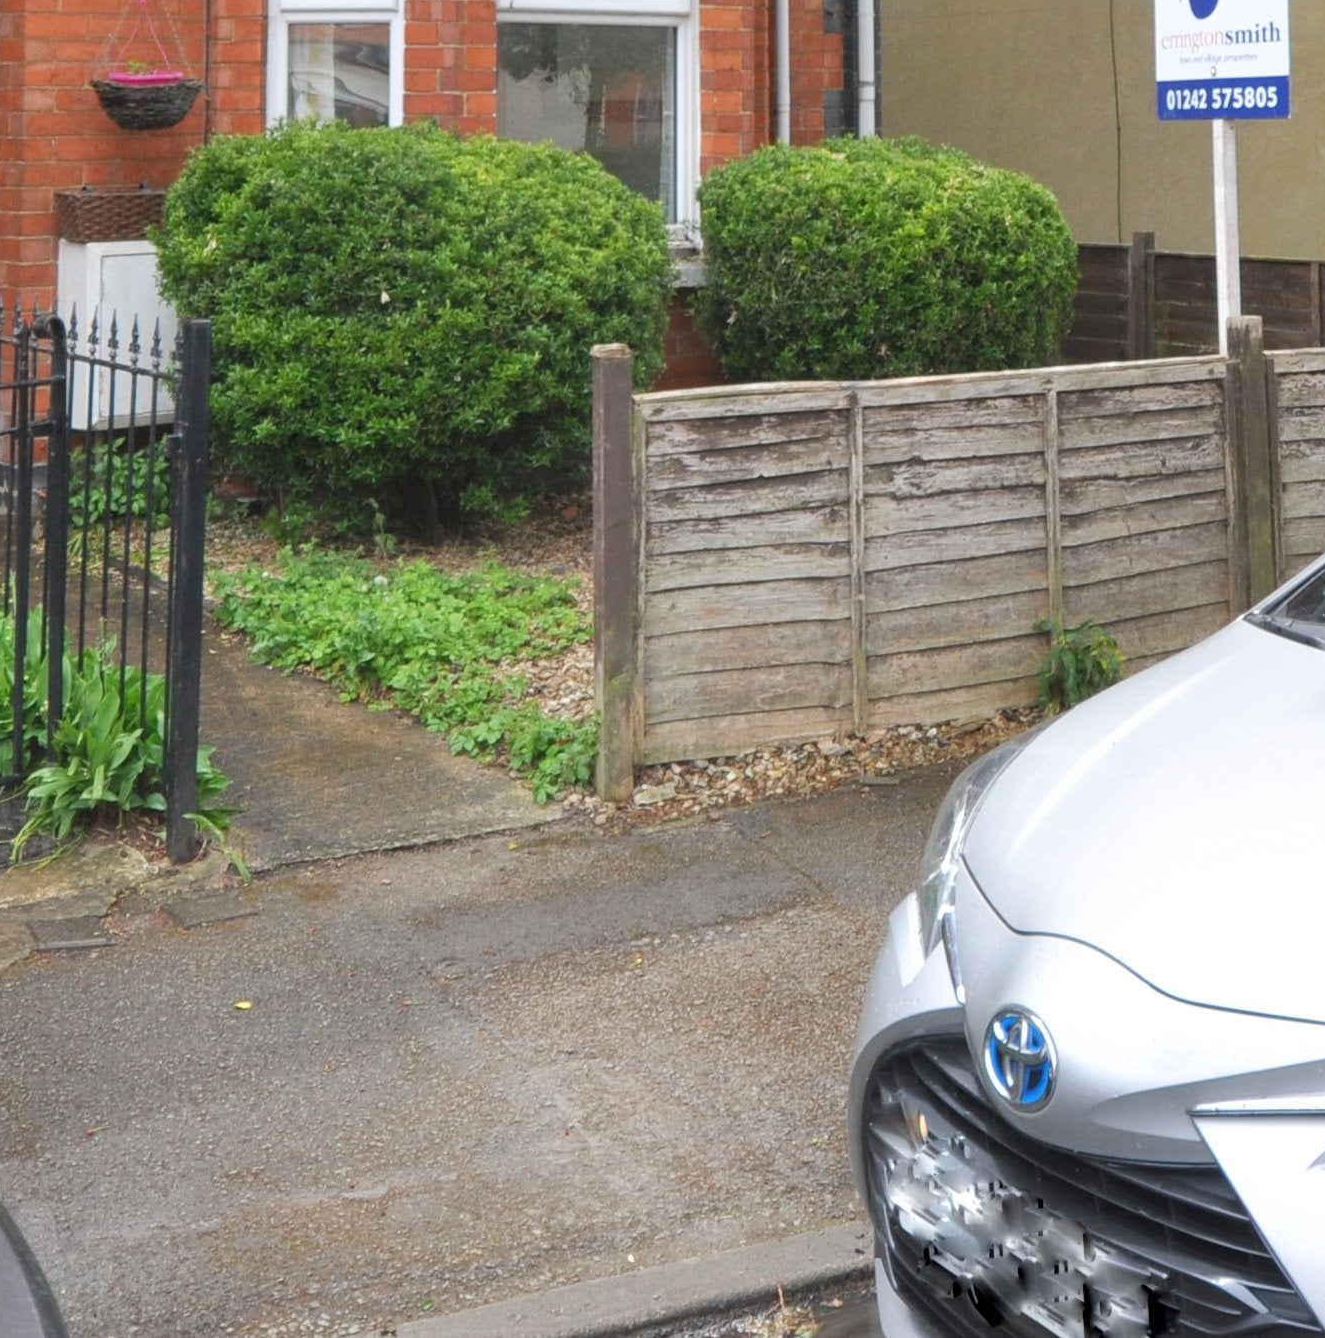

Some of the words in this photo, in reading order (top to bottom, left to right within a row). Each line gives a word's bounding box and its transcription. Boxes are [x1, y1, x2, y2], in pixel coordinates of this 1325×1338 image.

[1161, 21, 1281, 54] erringtonsmith
[1166, 88, 1208, 111] 01242
[1211, 86, 1278, 110] 575805
